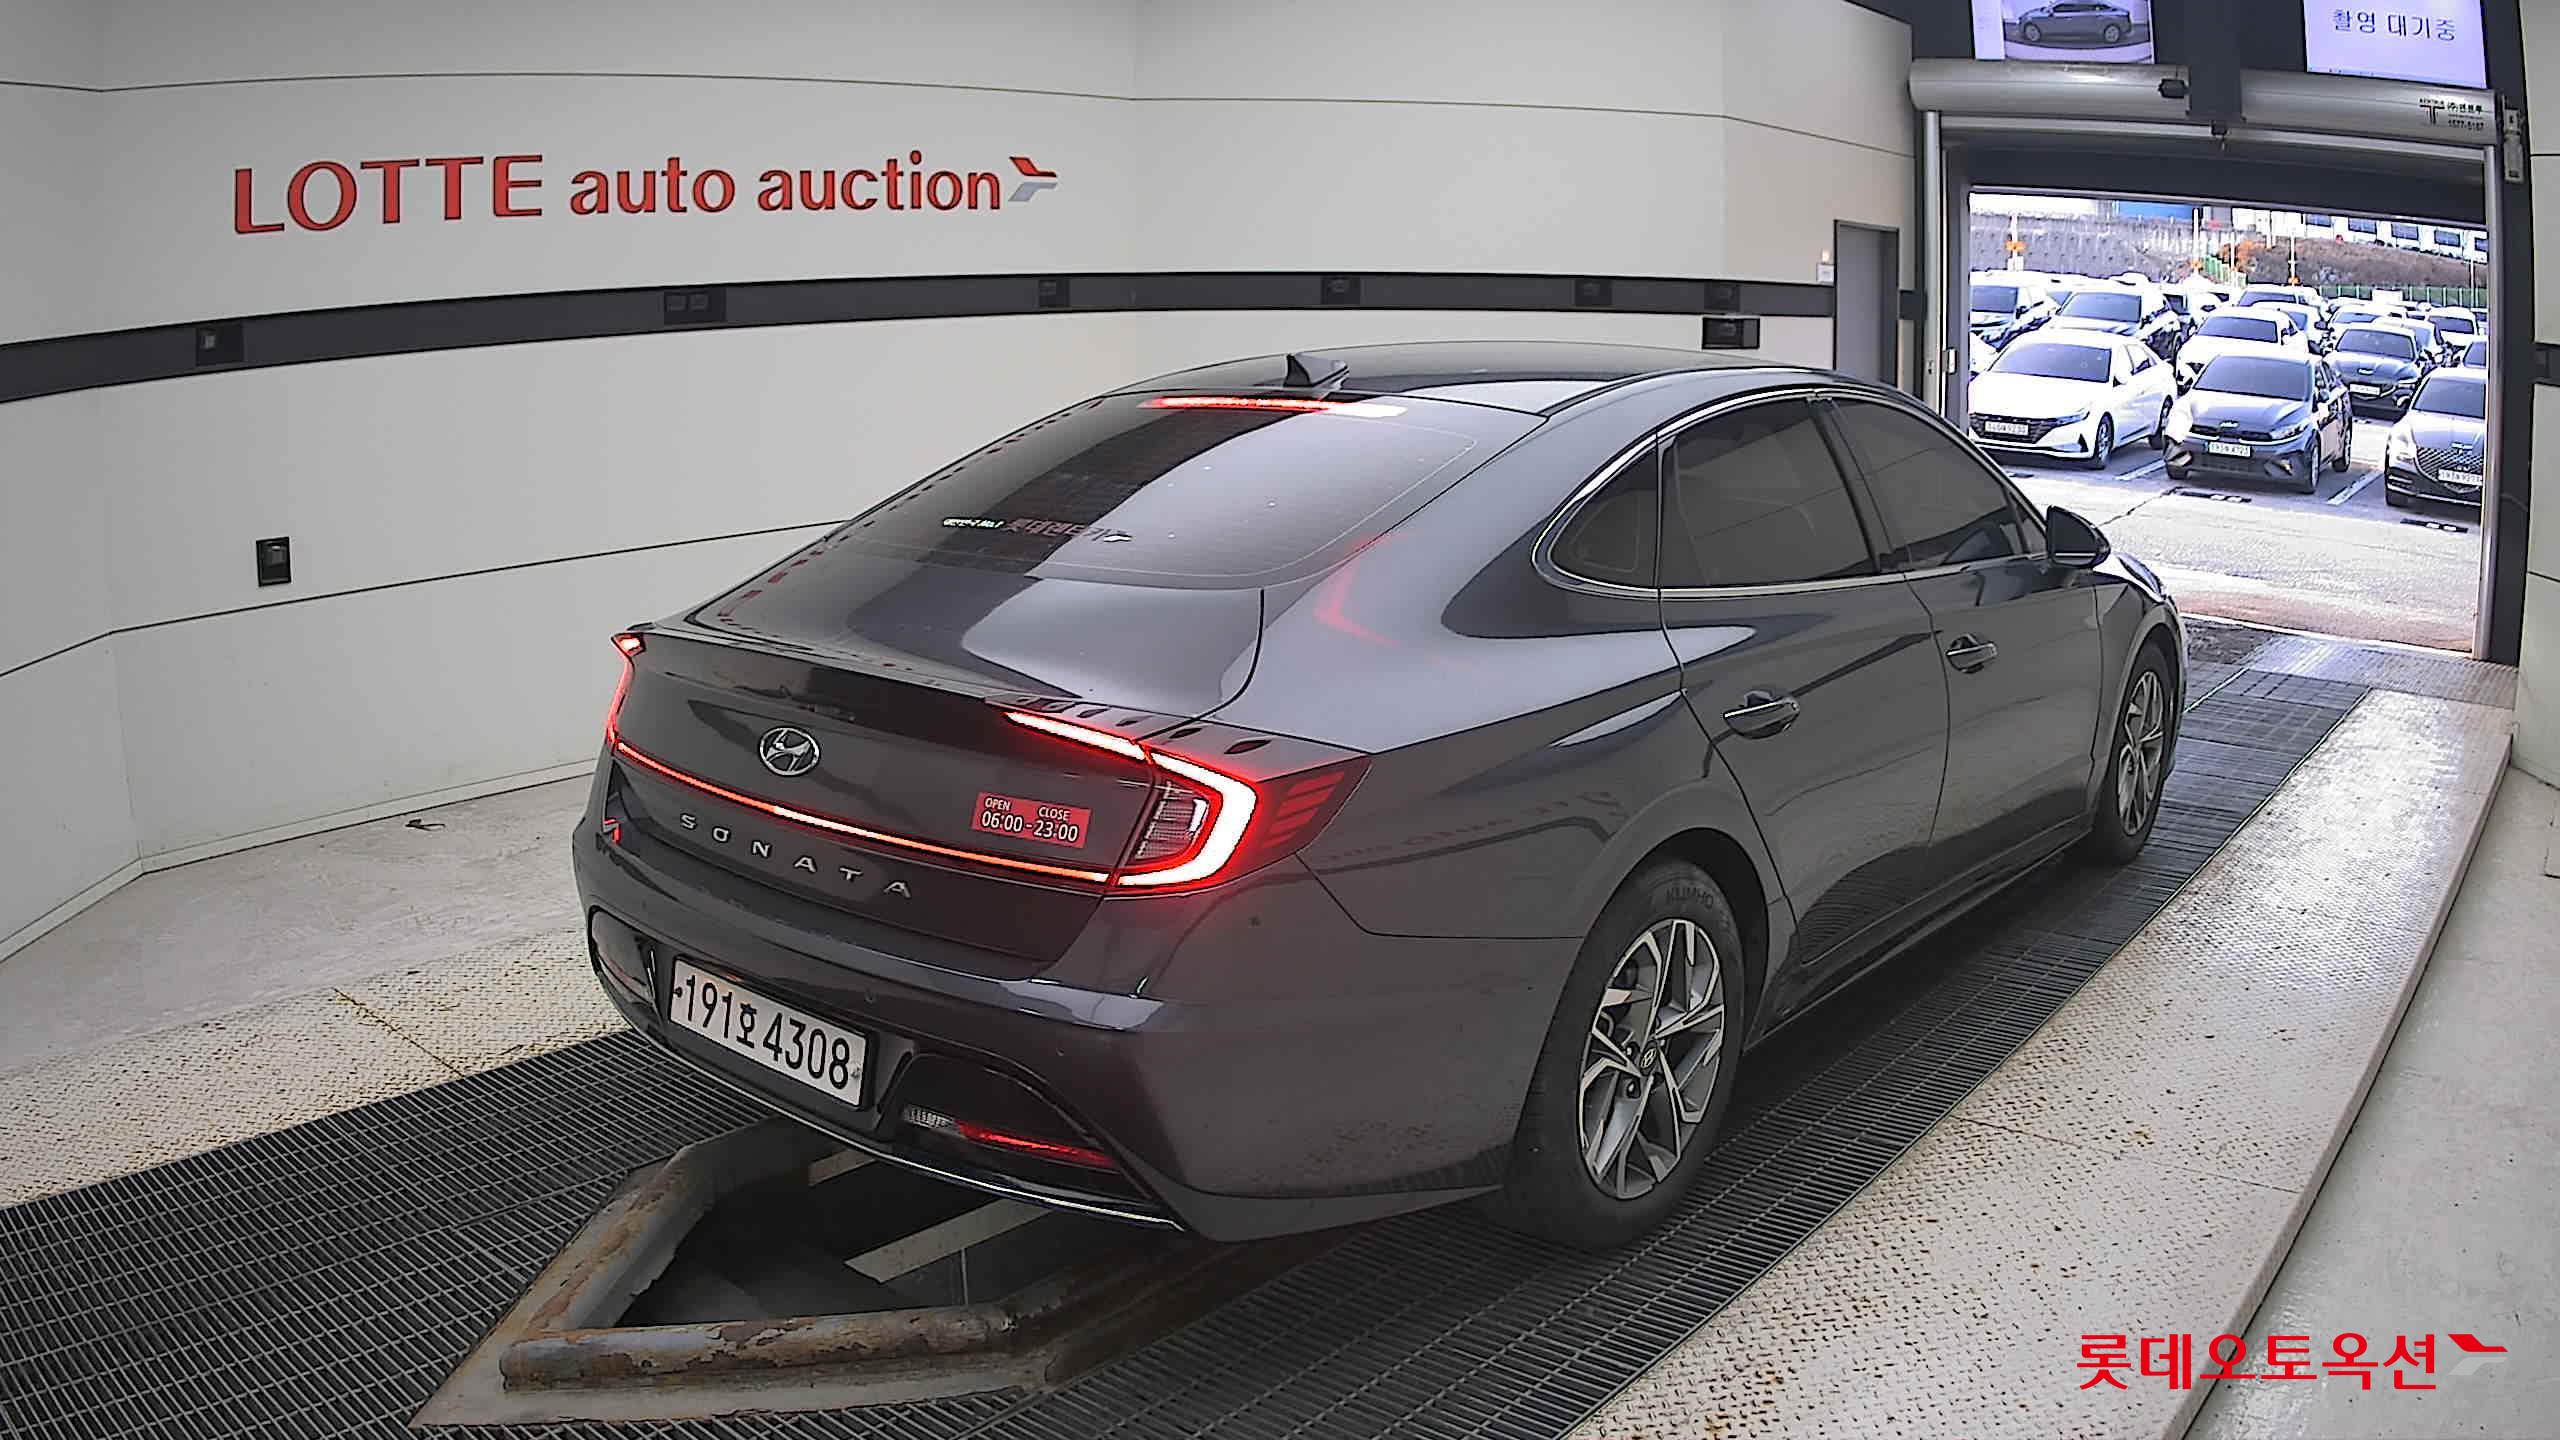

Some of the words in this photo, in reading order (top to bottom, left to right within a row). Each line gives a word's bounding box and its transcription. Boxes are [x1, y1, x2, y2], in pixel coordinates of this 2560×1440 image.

[2333, 9, 2376, 34] 촬영
[2387, 14, 2456, 42] 대기중
[234, 154, 543, 234] LOTTE
[570, 156, 736, 215] auto
[756, 149, 1001, 211] auction
[984, 797, 1011, 812] OPEN
[1037, 805, 1072, 822] CLOSE
[680, 812, 913, 898] SONATA
[686, 974, 851, 1090] 191호4308
